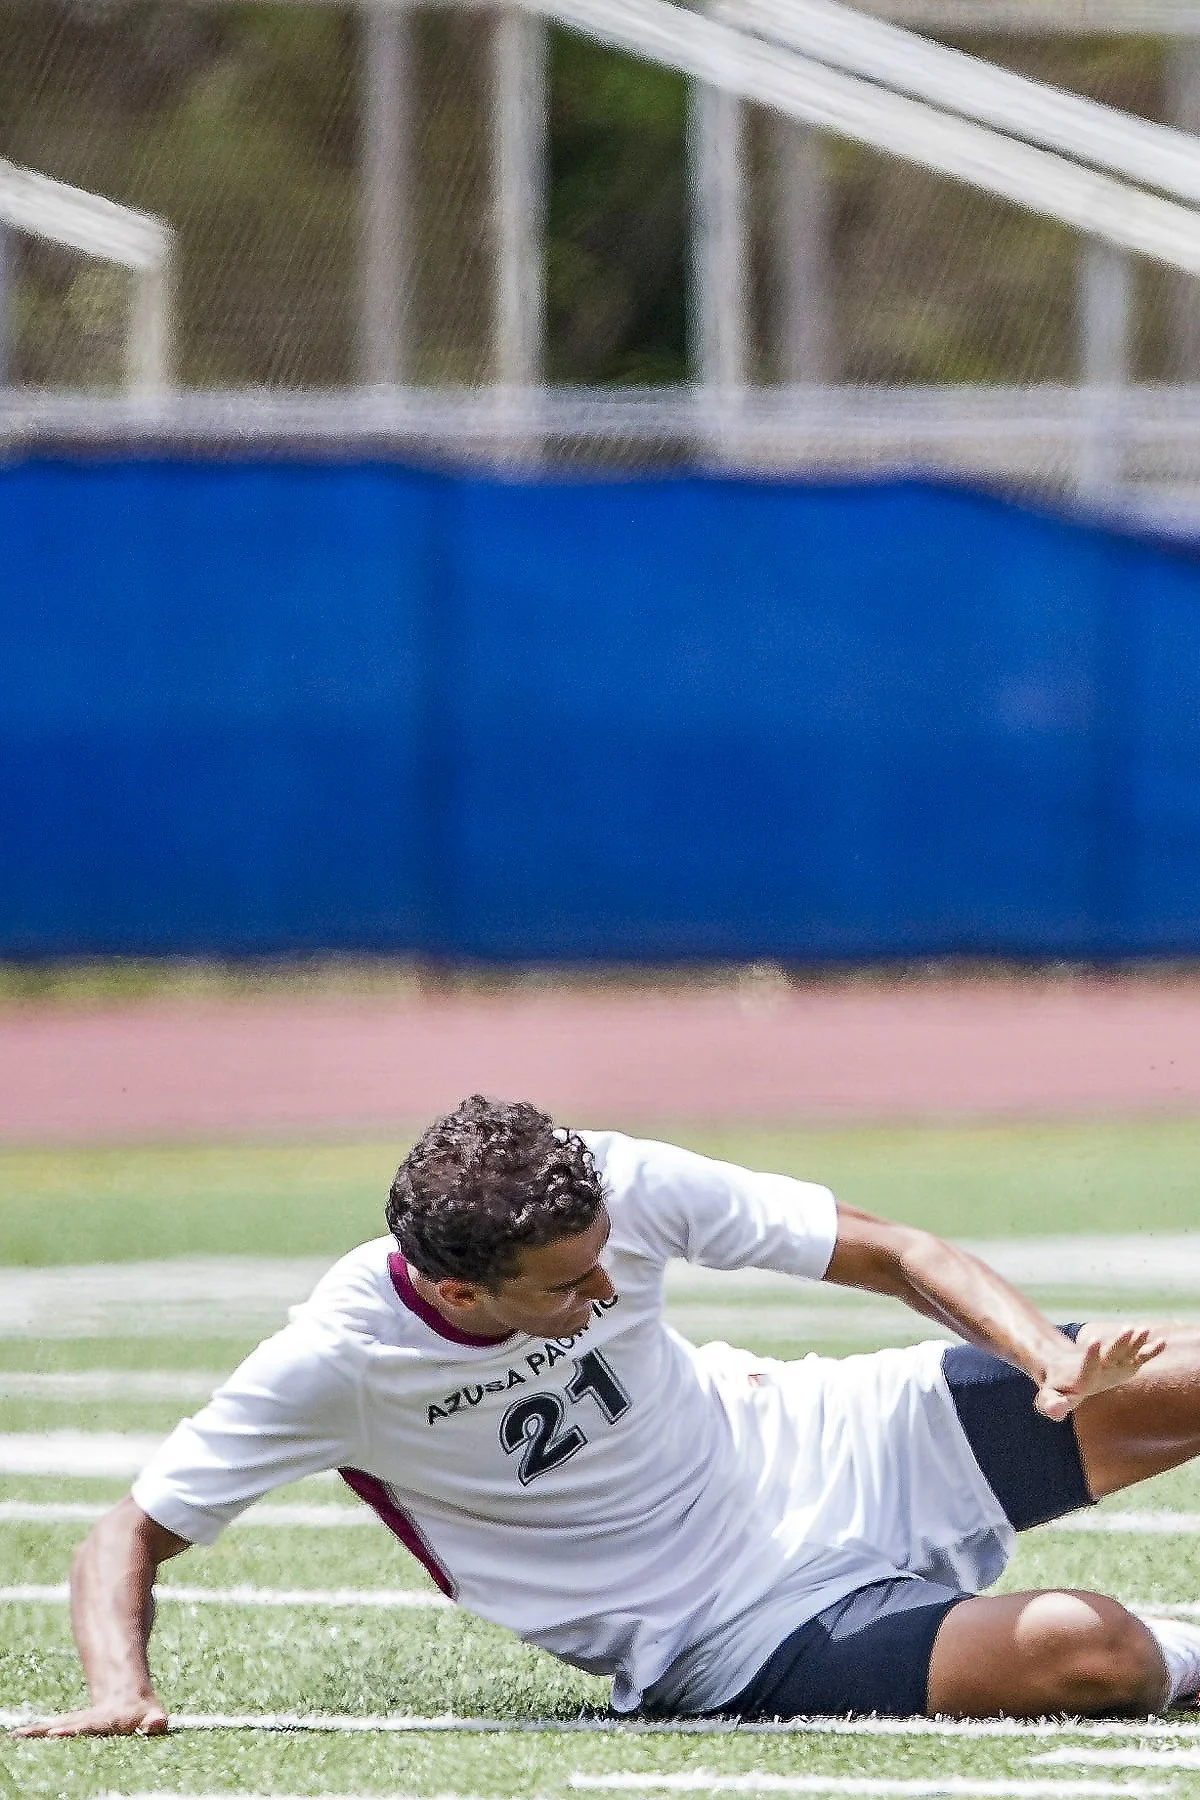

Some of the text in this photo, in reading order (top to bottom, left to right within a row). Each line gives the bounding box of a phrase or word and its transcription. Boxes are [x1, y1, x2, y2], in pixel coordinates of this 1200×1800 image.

[426, 1294, 619, 1425] AZUSA PACIC
[499, 1346, 633, 1487] 21
